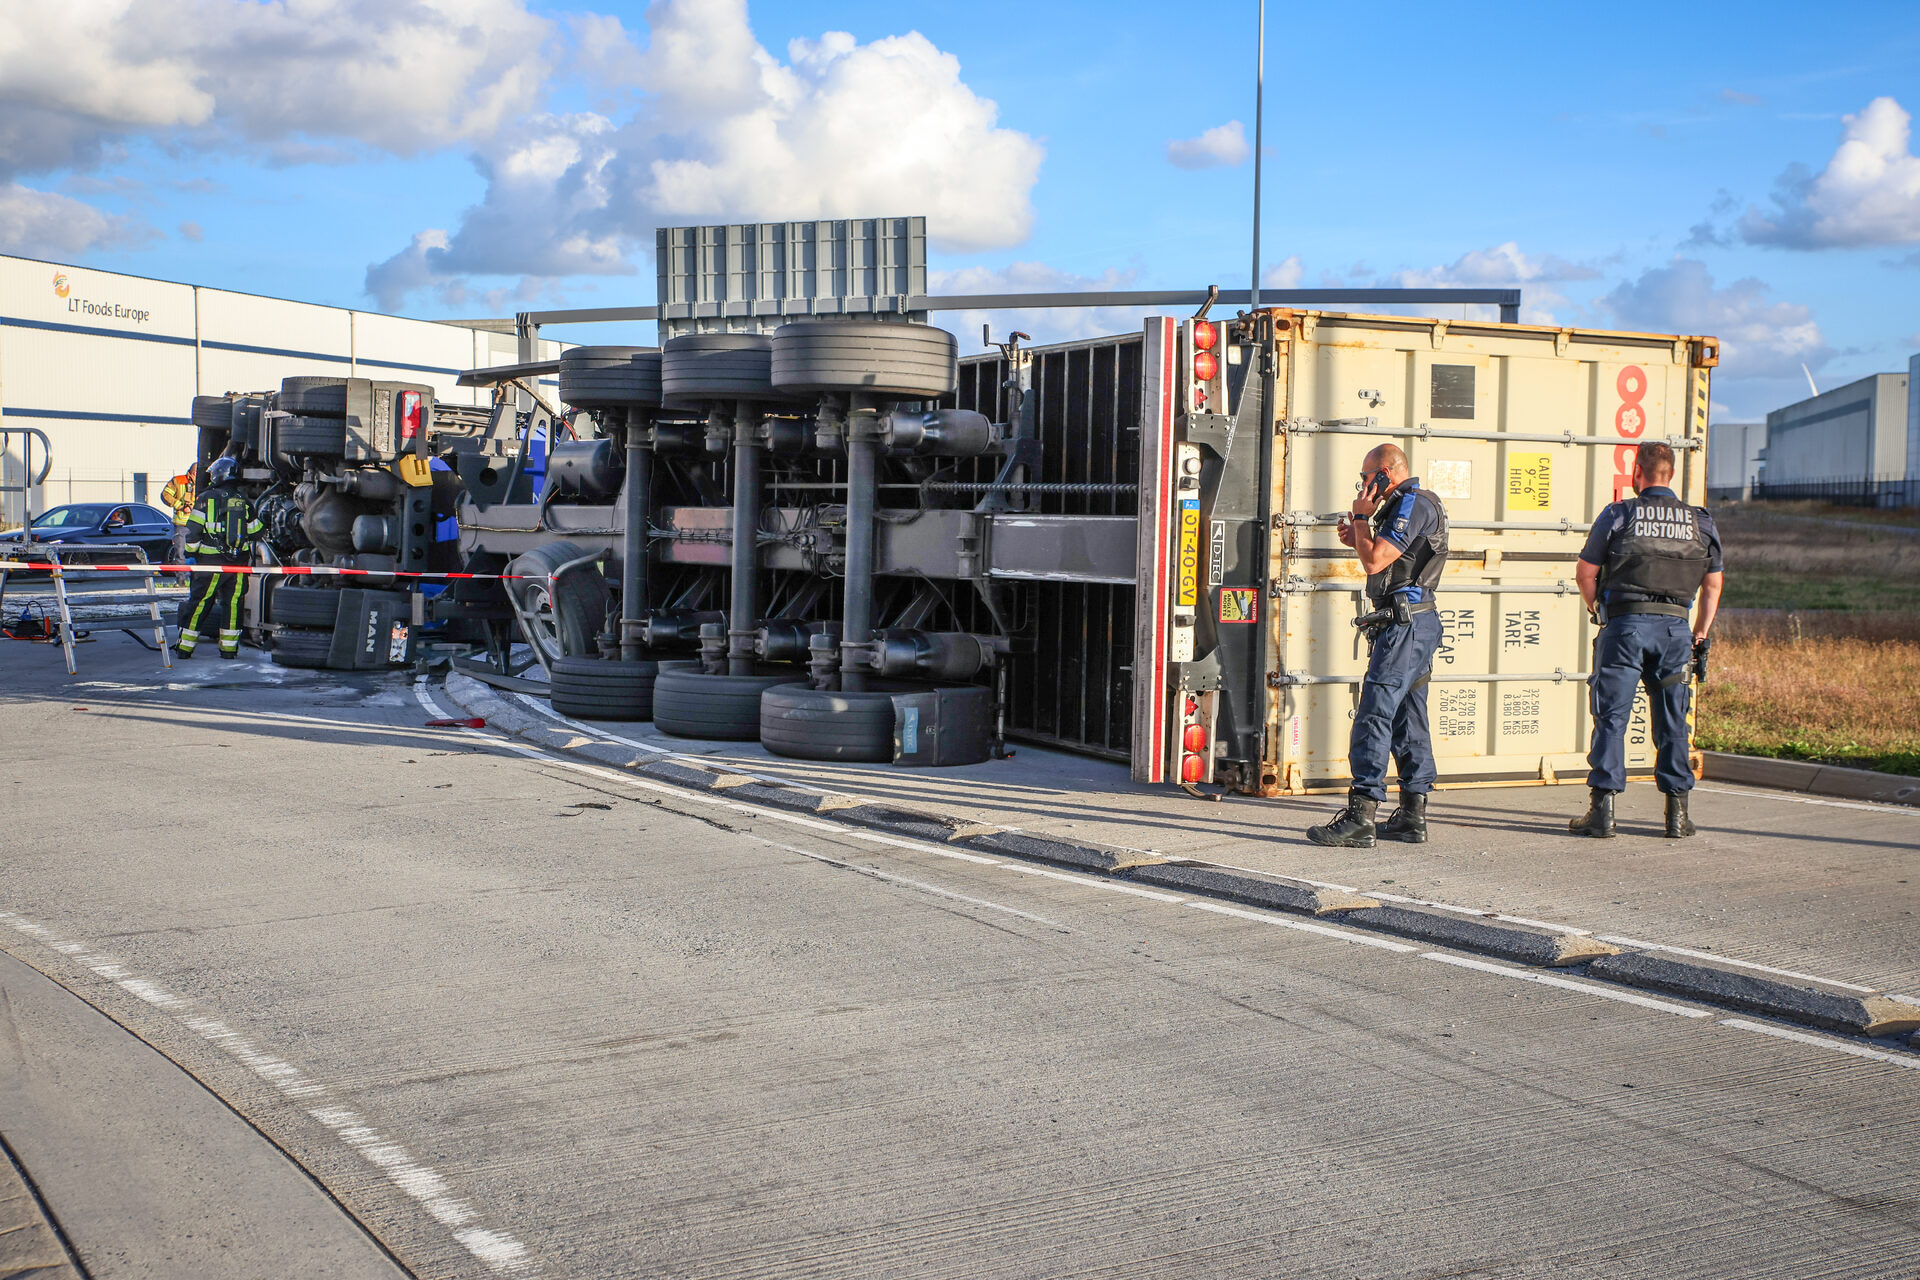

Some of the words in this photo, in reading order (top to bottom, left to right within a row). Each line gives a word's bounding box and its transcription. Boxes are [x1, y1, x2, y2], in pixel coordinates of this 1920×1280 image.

[68, 297, 80, 312] LT
[82, 300, 113, 317] Foods
[114, 303, 150, 324] Europe
[1510, 468, 1522, 495] HIGH
[1538, 457, 1550, 507] CAUTION
[1636, 506, 1693, 524] DOUANE
[1634, 521, 1694, 541] CUSTOMS
[1182, 514, 1198, 599] OT-40-GV
[1211, 544, 1221, 581] D-TEC
[366, 611, 378, 652] MAN
[1458, 610, 1474, 642] NET.
[1504, 611, 1522, 652] TARE.
[1523, 610, 1540, 648] MGW.
[1531, 688, 1540, 716] 32.500
[1630, 686, 1646, 744] 865478
[1458, 721, 1466, 736] LBS
[1467, 720, 1476, 736] KGS
[1503, 720, 1512, 736] LBS
[1512, 720, 1521, 735] KGS
[1521, 720, 1530, 734] LBS
[1530, 720, 1539, 734] KGS
